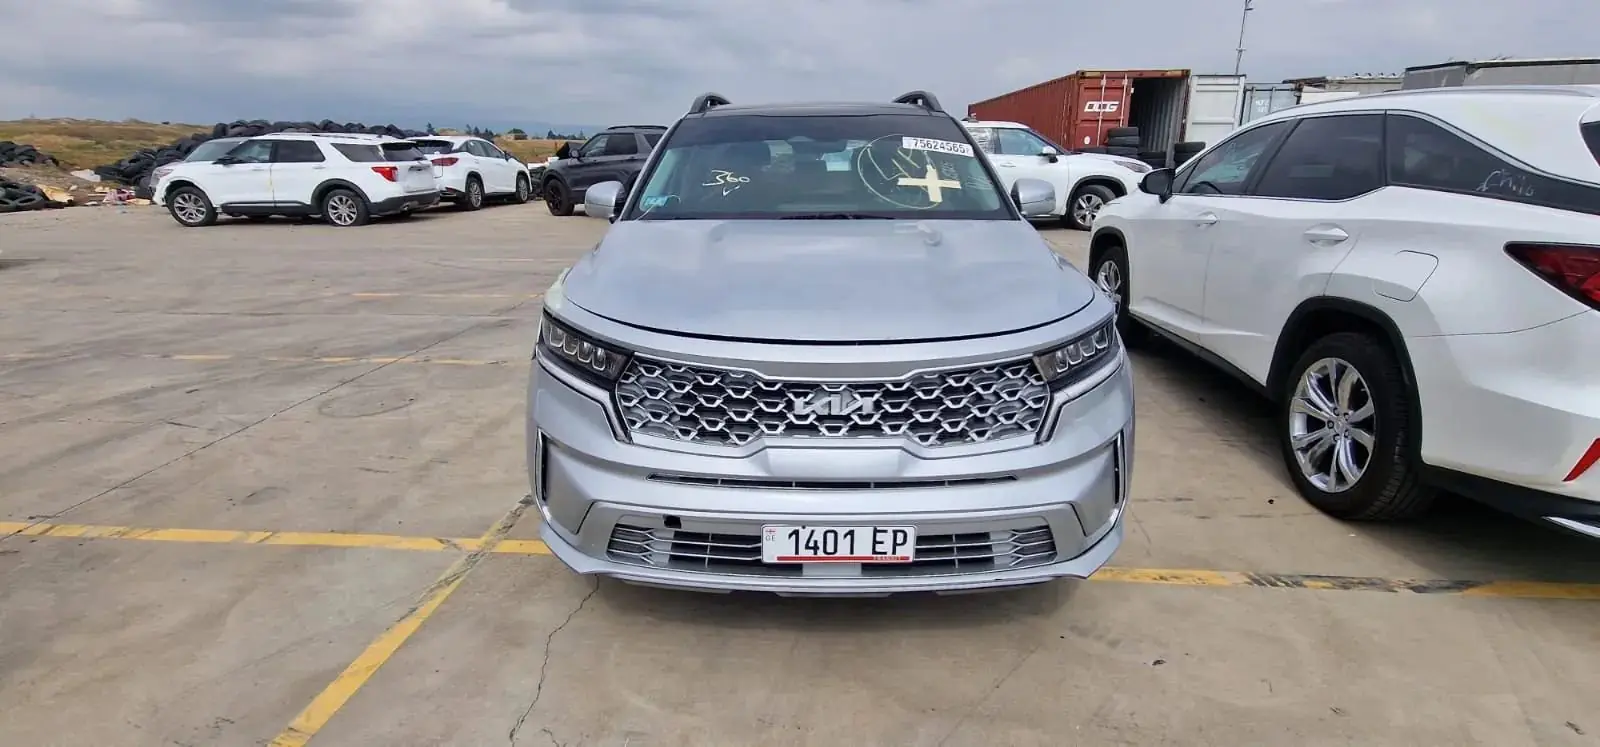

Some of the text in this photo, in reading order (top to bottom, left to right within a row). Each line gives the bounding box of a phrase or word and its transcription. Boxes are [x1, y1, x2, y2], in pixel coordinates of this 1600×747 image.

[702, 169, 751, 187] 360
[794, 394, 875, 415] KIA
[788, 526, 908, 556] 1401 EP
